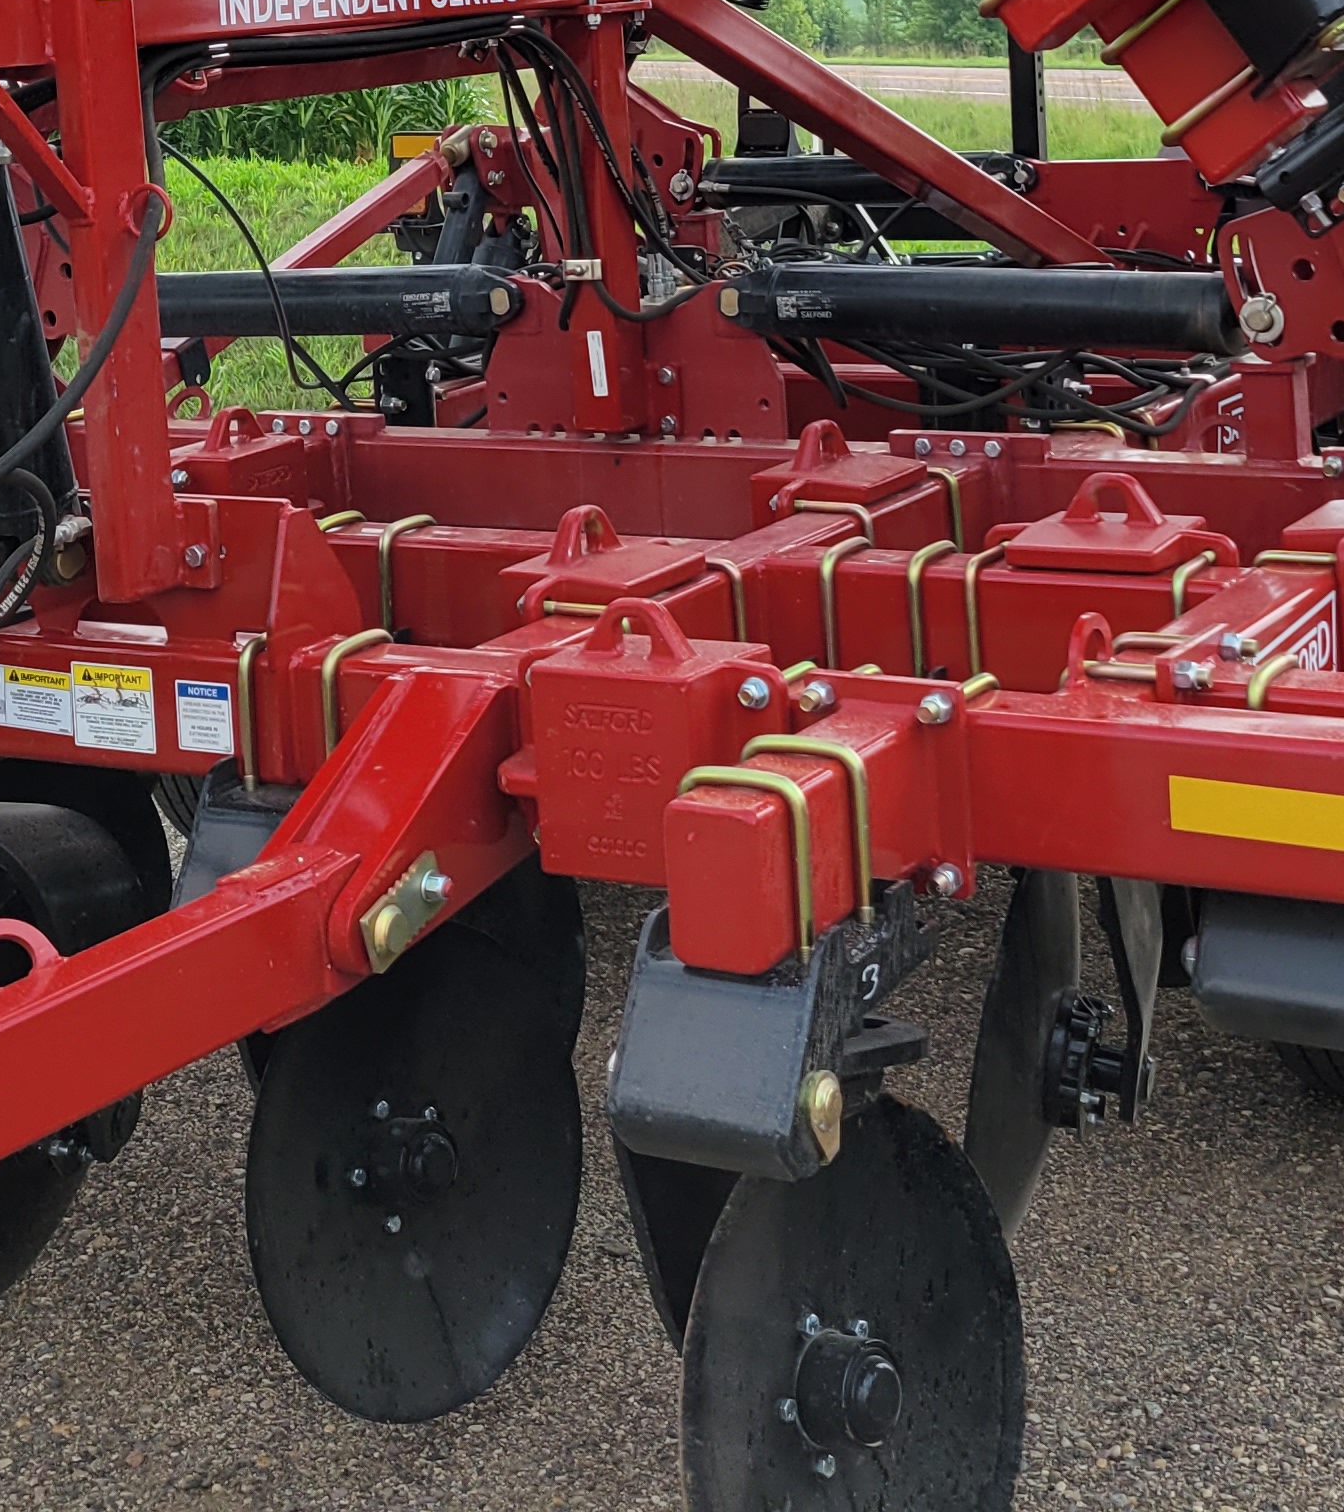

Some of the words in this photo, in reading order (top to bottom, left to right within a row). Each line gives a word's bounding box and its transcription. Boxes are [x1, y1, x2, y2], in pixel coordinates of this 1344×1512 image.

[17, 575, 31, 595] 210
[1, 590, 19, 612] BAR
[21, 672, 67, 687] IMPORTANT
[94, 672, 143, 685] IMPORTANT
[187, 686, 218, 698] NOTICE
[564, 703, 654, 736] SALFORD
[561, 746, 605, 781] 100
[615, 753, 662, 786] LBS
[861, 963, 881, 1001] 3
